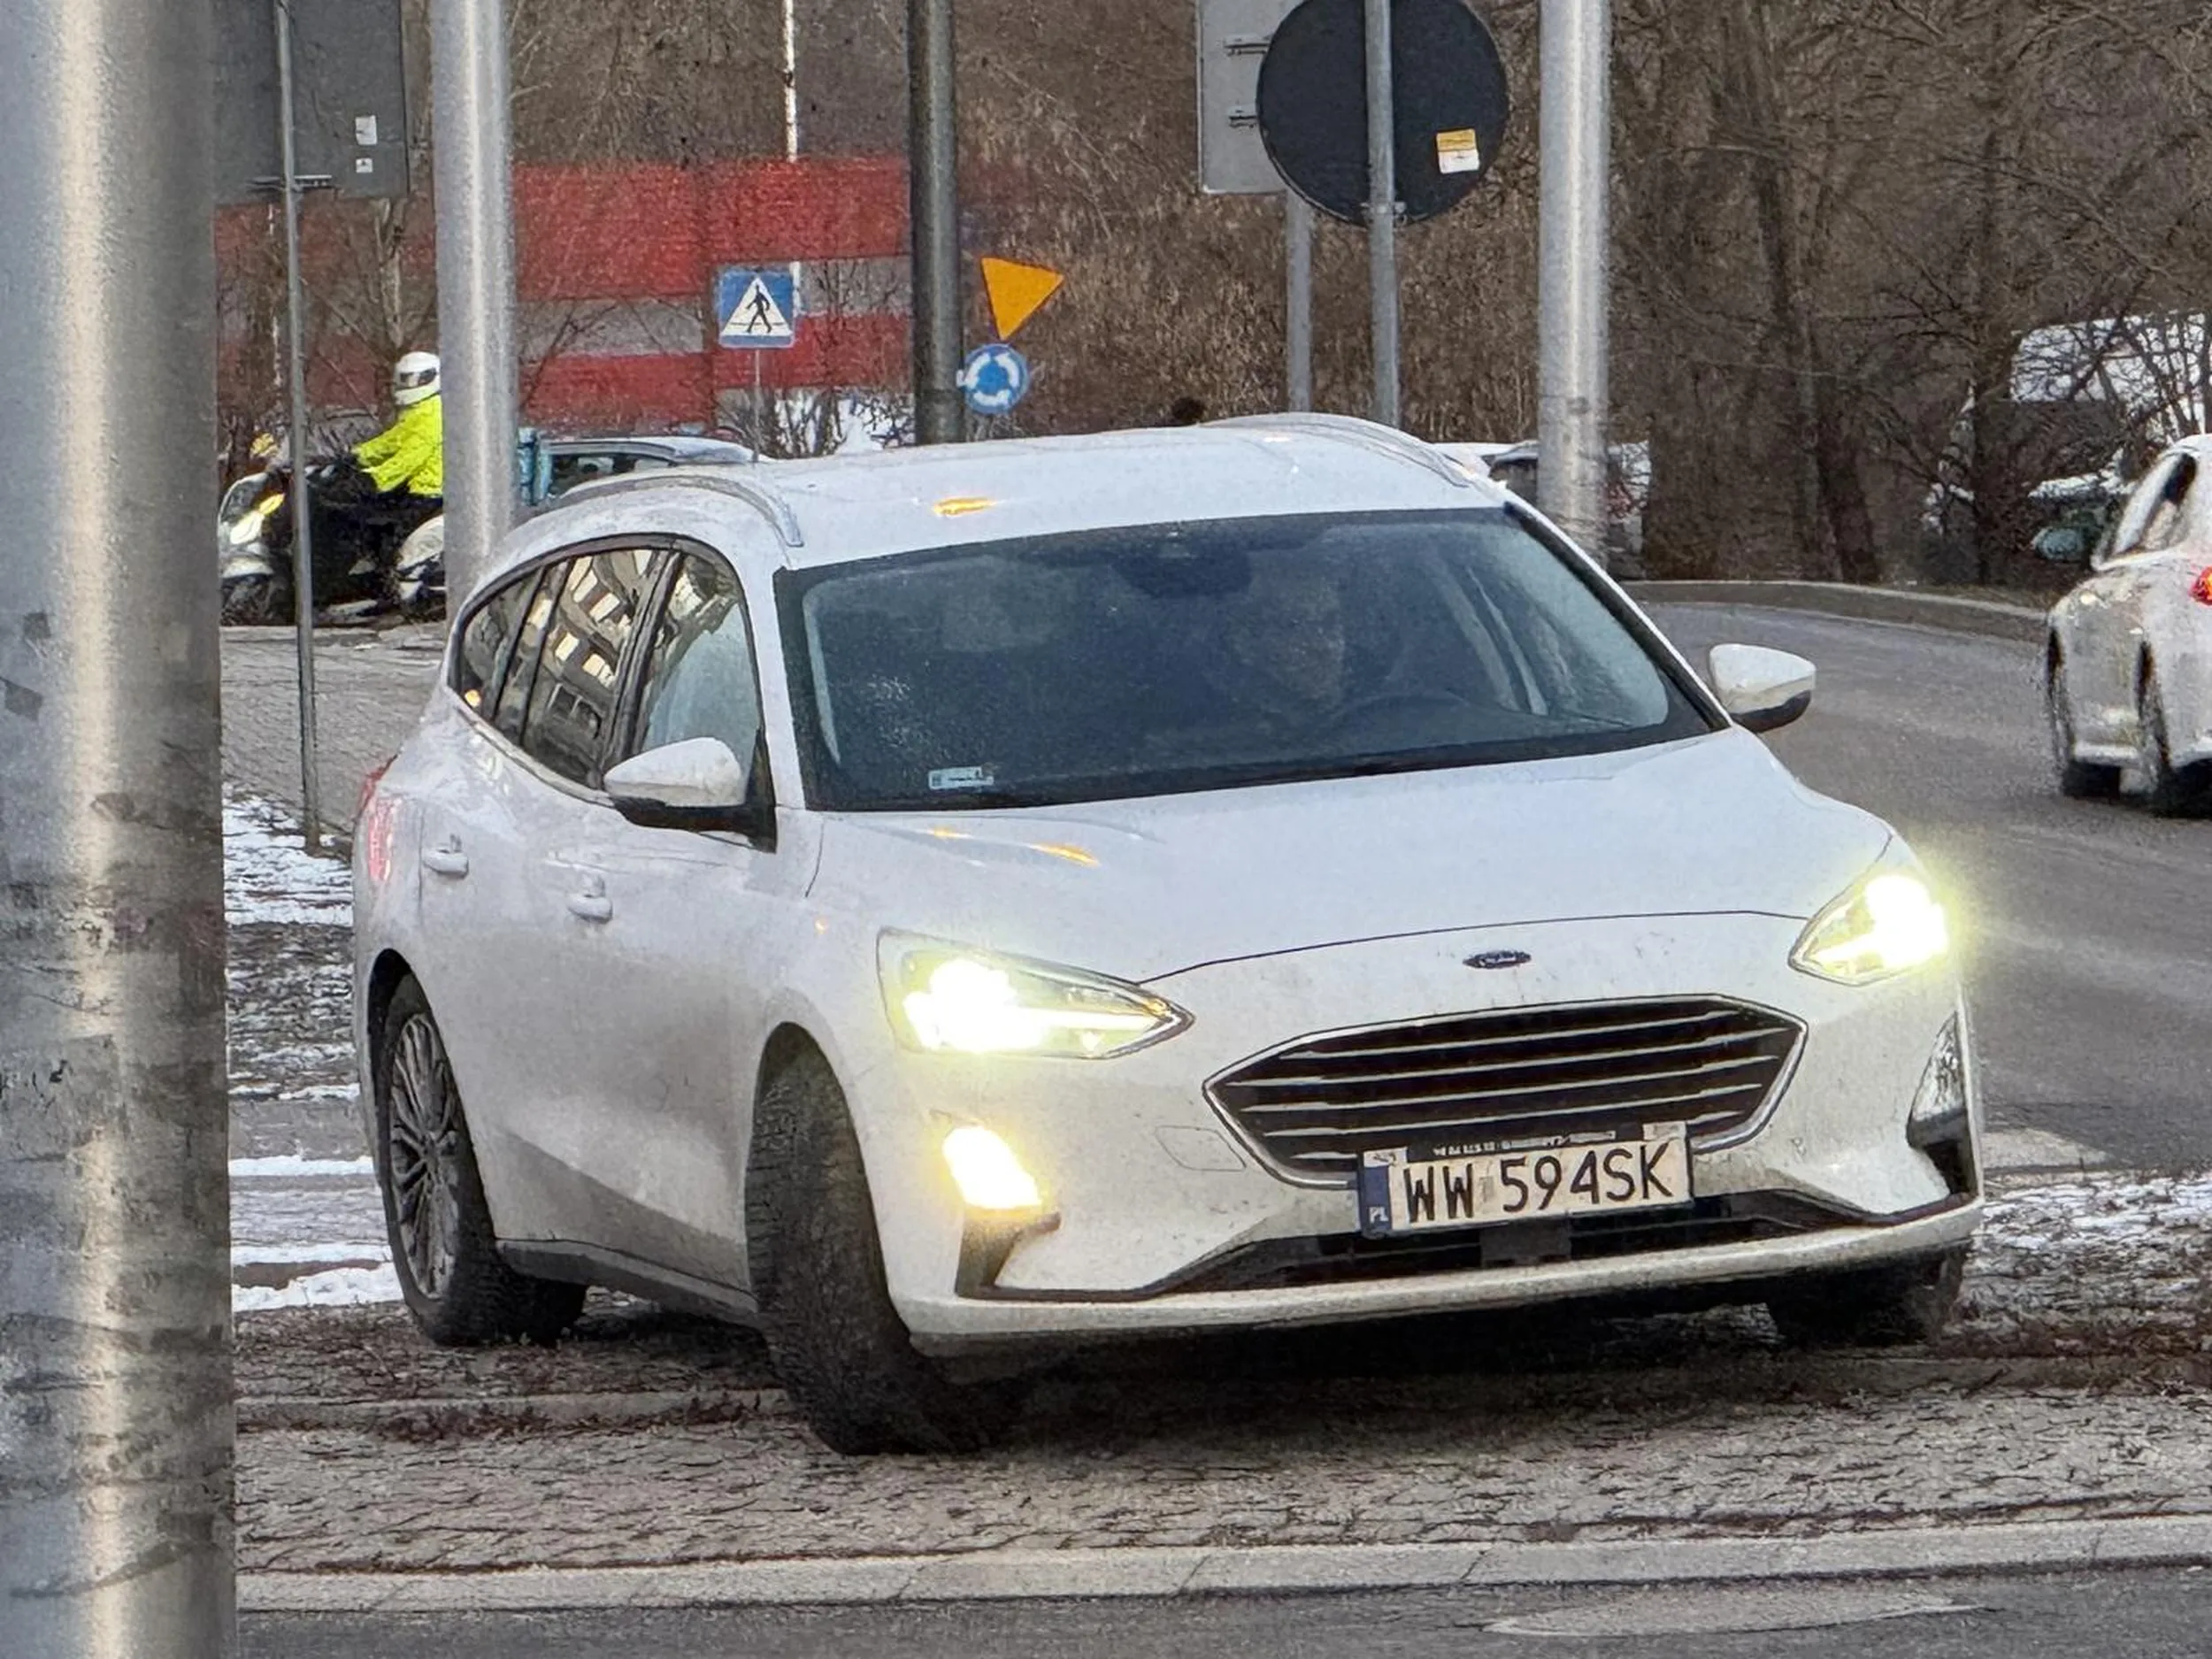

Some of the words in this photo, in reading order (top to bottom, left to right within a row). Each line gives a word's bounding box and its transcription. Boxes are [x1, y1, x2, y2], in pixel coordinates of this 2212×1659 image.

[1403, 1164, 1475, 1223] WW
[1500, 1141, 1674, 1213] 594SK
[1369, 1206, 1390, 1224] PL
